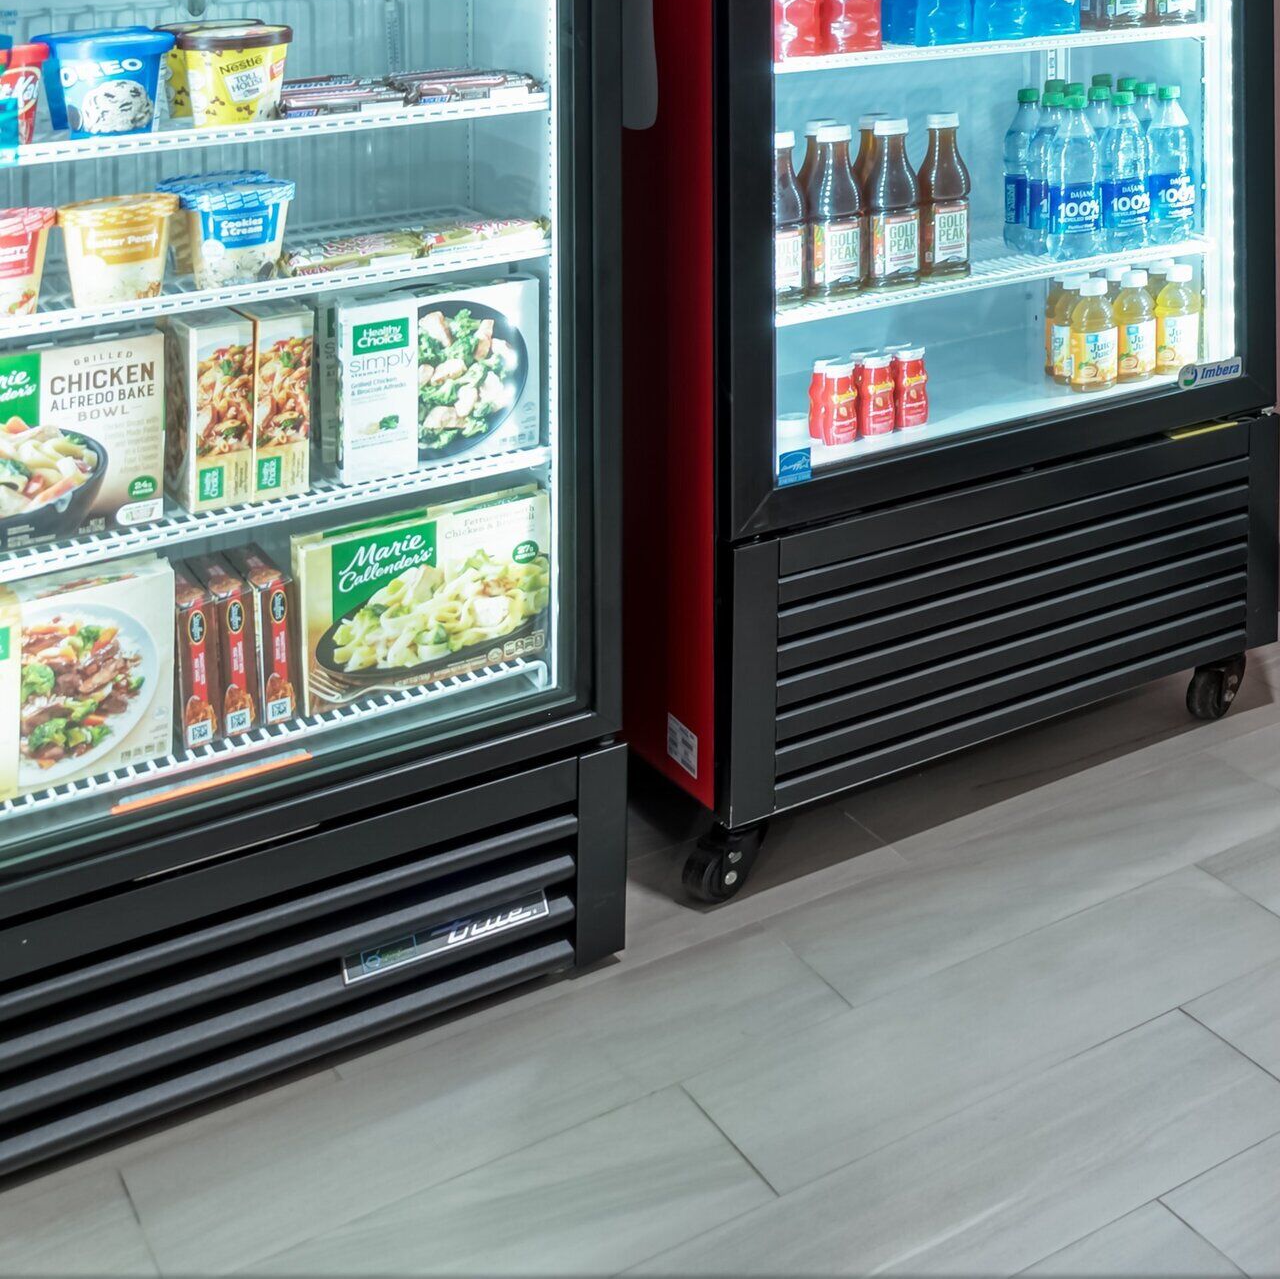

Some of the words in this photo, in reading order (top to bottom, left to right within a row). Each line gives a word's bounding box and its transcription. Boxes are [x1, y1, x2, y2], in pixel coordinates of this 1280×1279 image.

[60, 58, 143, 88] OREO
[1111, 192, 1151, 212] 100%
[1158, 185, 1196, 203] 100%
[1058, 199, 1099, 219] 100%
[221, 217, 263, 229] Cookies
[939, 213, 965, 229] GOLD
[221, 227, 230, 237] &
[230, 224, 263, 236] Cream
[830, 230, 858, 247] GOLD
[889, 223, 916, 239] GOLD
[939, 227, 965, 242] PEAK
[830, 246, 858, 261] PEAK
[889, 238, 916, 252] PEAK
[363, 324, 402, 338] Healthy
[357, 334, 403, 349] Choice
[74, 350, 133, 366] GRILLED
[350, 350, 416, 374] simply
[51, 361, 155, 396] CHICKEN
[1200, 362, 1240, 380] Imbera
[51, 391, 114, 412] ALFREDO
[118, 383, 155, 401] BAKE
[78, 404, 130, 422] BOWL
[445, 525, 485, 540] Chicken
[338, 533, 426, 576] Marie
[338, 547, 433, 593] Callender's
